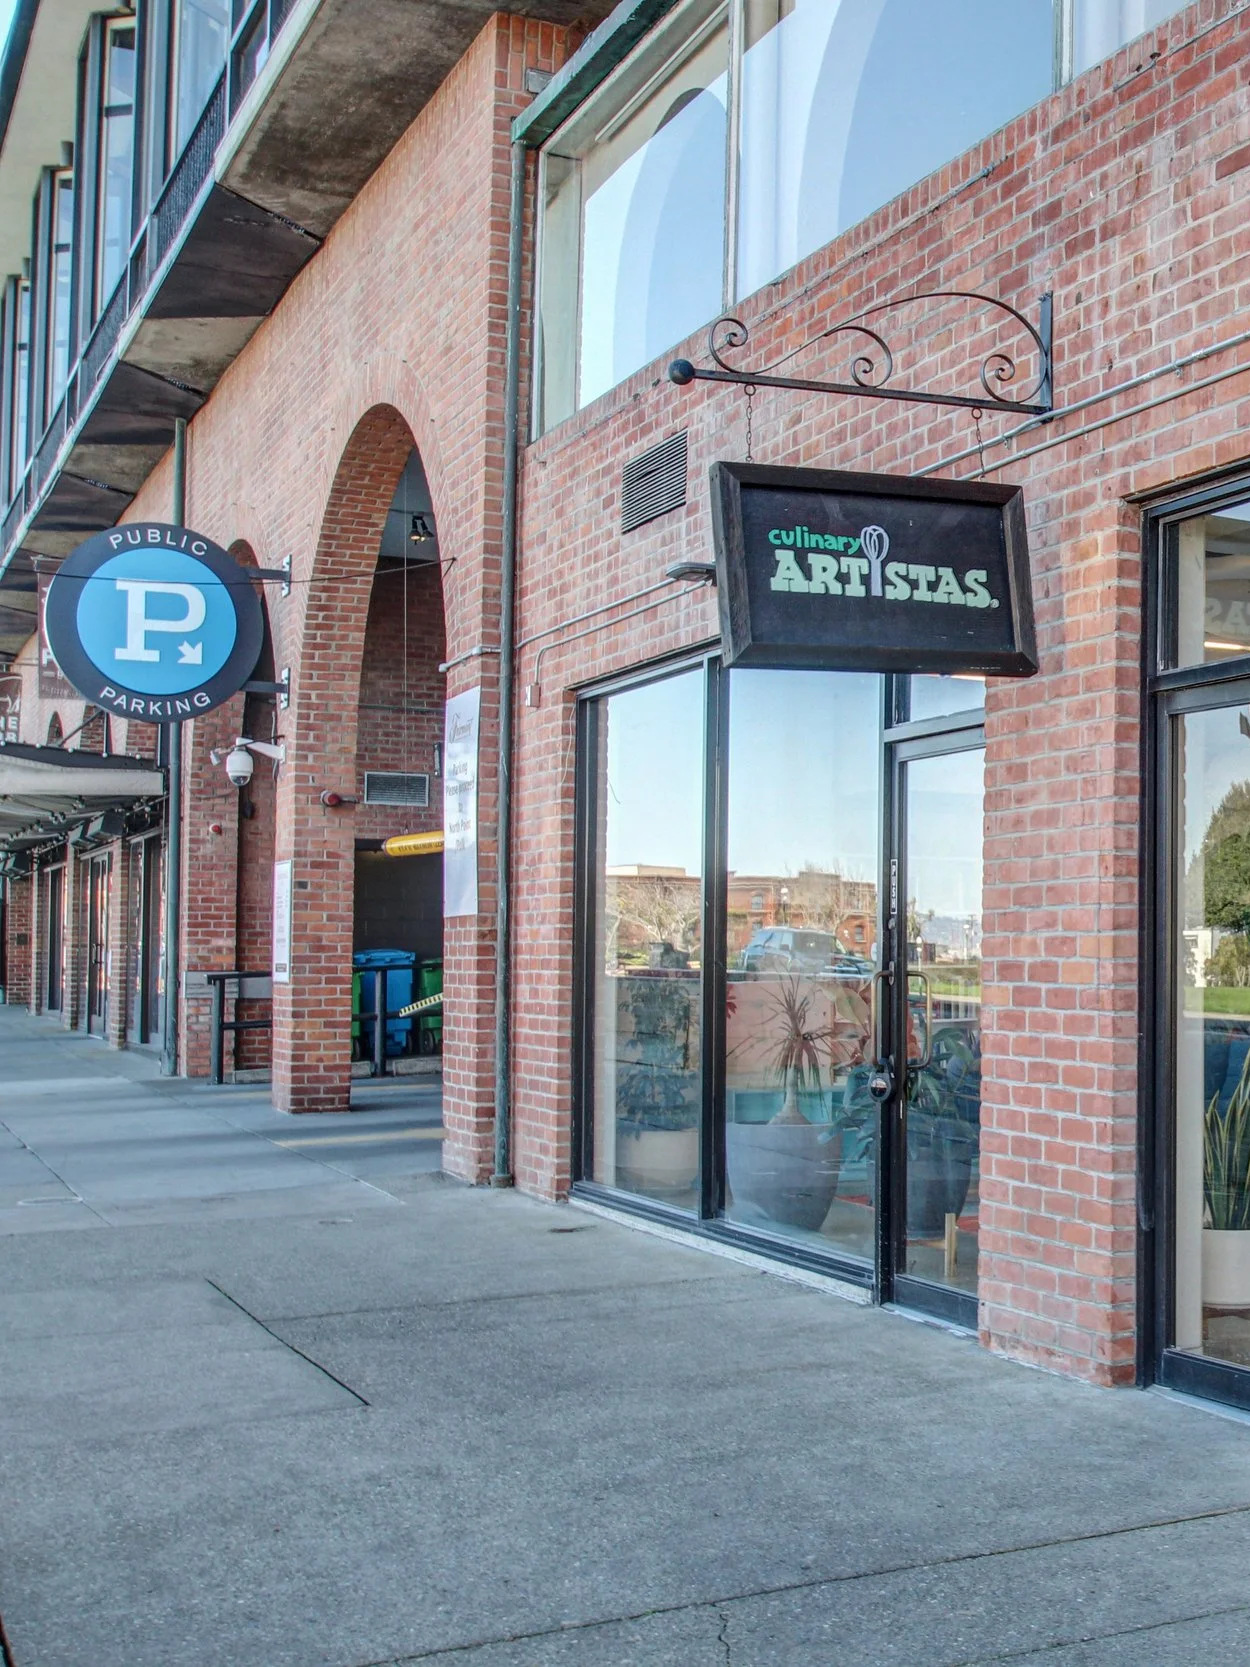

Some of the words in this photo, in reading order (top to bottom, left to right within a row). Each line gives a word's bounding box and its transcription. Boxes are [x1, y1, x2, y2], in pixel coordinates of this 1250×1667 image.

[109, 529, 208, 556] PUBLIC
[768, 525, 861, 555] culinary
[114, 577, 206, 662] P
[100, 686, 211, 716] PARKING
